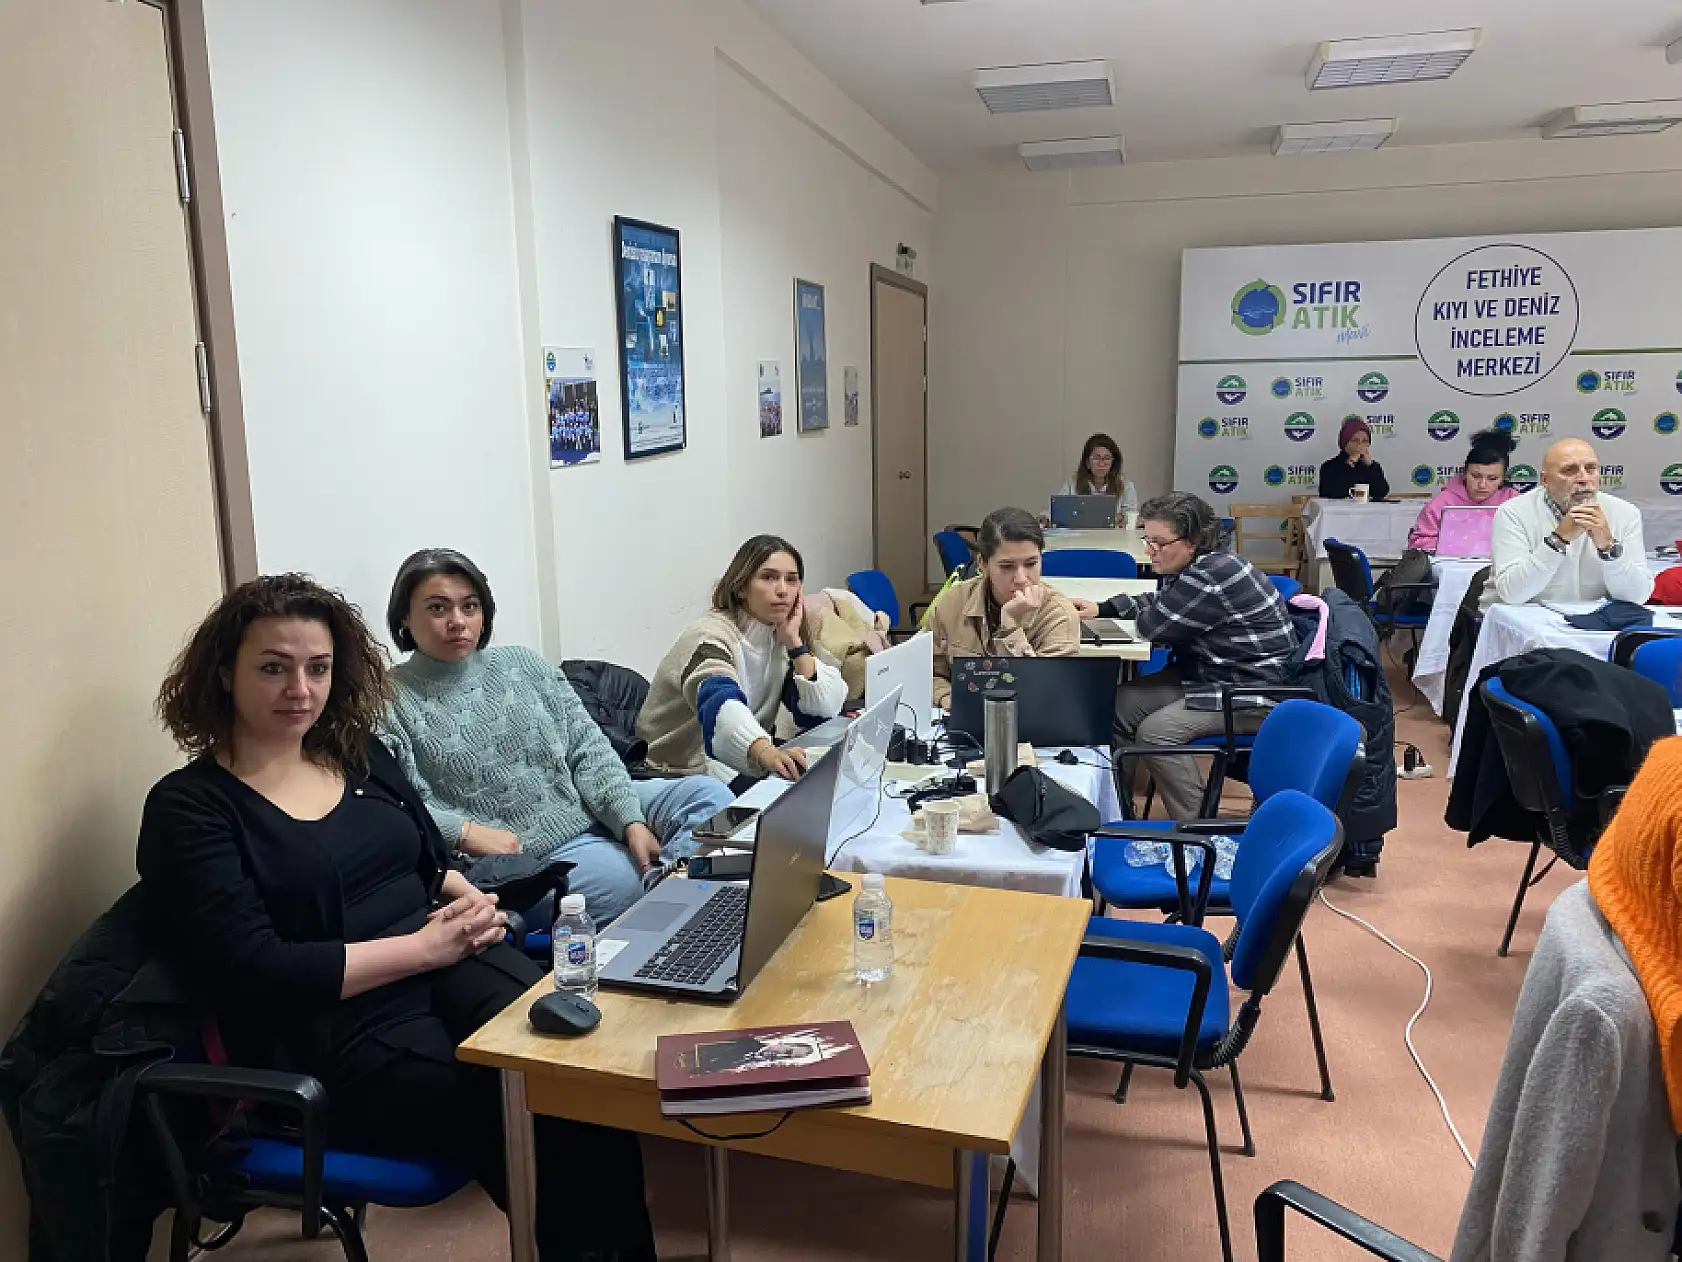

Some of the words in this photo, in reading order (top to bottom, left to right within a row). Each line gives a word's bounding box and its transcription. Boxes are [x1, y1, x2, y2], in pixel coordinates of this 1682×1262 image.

[1466, 264, 1543, 290] FETHİYE
[1292, 280, 1361, 304] SIFIR
[1432, 301, 1468, 321] KIYI
[1474, 299, 1499, 319] VE
[1504, 292, 1561, 317] DENİZ
[1291, 304, 1361, 329] ATIK
[1450, 325, 1547, 349] İNCELEME
[1456, 351, 1541, 378] MERKEZİ
[1294, 376, 1324, 387] SIFIR
[1604, 370, 1635, 381] SIFIR
[1221, 417, 1249, 427] SIFIR
[1287, 464, 1316, 475] SIFIR
[1600, 465, 1624, 475] IFIR
[1599, 475, 1623, 485] TIK
